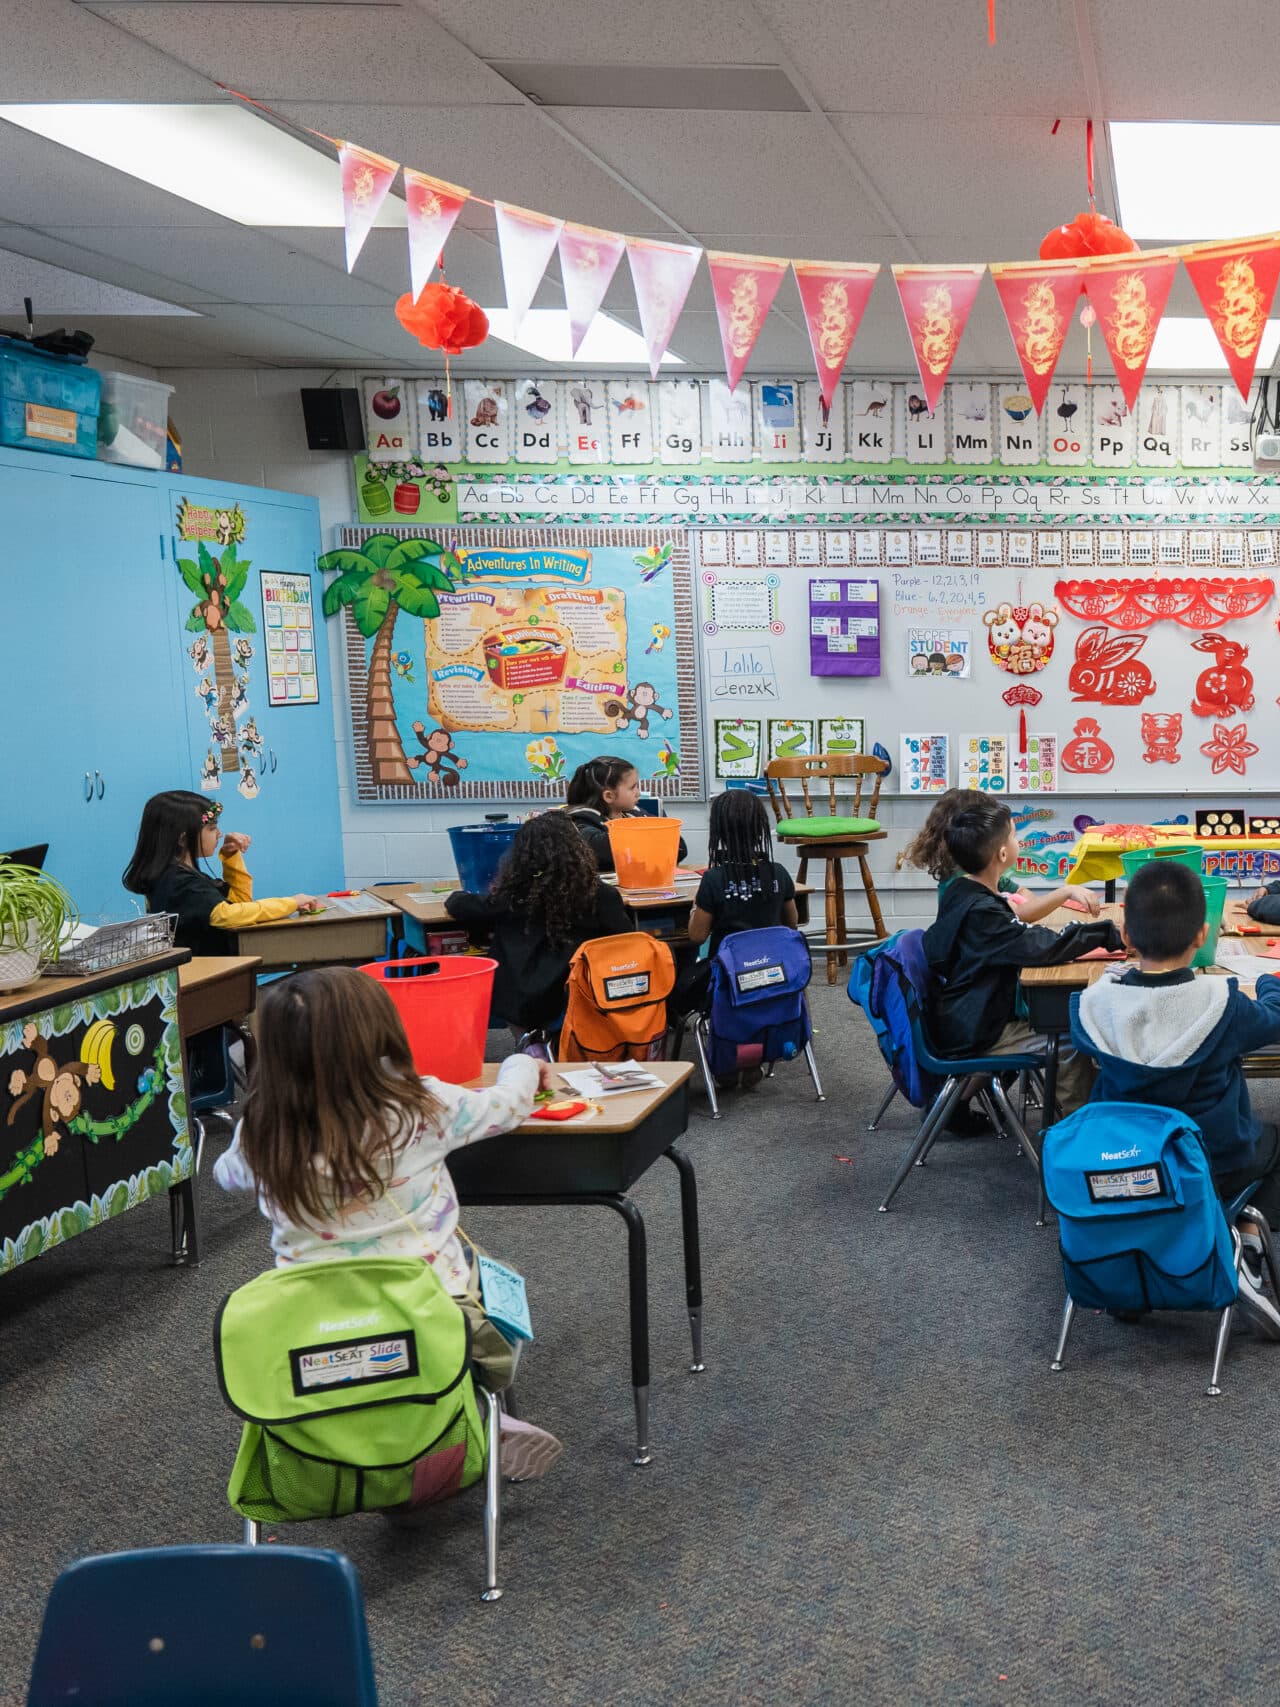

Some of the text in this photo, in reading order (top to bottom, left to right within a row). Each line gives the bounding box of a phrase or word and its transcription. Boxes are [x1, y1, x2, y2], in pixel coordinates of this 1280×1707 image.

[376, 433, 403, 449] Aa
[427, 433, 452, 447] Bb
[475, 433, 499, 448] Cc
[523, 433, 550, 448] Dd
[577, 436, 599, 450] Ee
[621, 434, 641, 449] Ff
[666, 434, 693, 453] Gg
[719, 432, 744, 447] Hh
[773, 434, 787, 449] Ii
[815, 432, 832, 451] Jj
[859, 433, 883, 448] Kk
[918, 434, 933, 449] Ll
[956, 435, 988, 449] Mm
[1007, 436, 1032, 449] Nn
[1053, 437, 1081, 453] Oo
[1100, 438, 1124, 455] Pp
[1143, 437, 1172, 455] Qq
[1191, 437, 1211, 451] Rr
[1230, 438, 1249, 451] Ss
[464, 486, 488, 503] Aa
[535, 487, 558, 503] Cc
[571, 487, 594, 504] Dd
[609, 488, 628, 504] Ee
[639, 488, 660, 504] Ff
[673, 488, 700, 512] Gg
[710, 488, 734, 504] Hh
[771, 488, 792, 512] Jj
[805, 488, 826, 503] Kk
[841, 488, 858, 503] Ll
[872, 488, 904, 503] Mm
[914, 488, 937, 503] Nn
[946, 487, 971, 503] Oo
[981, 488, 1003, 511] Pp
[1012, 487, 1041, 512] Qq
[1049, 488, 1070, 504] Rr
[1081, 488, 1100, 504] Ss
[1109, 488, 1128, 504] Tt
[1175, 488, 1194, 504] Vv
[1207, 488, 1239, 504] Ww
[1247, 488, 1269, 504] Xx
[467, 557, 583, 576] Adventures In Writing
[266, 589, 309, 603] BIRTHDAY
[548, 592, 596, 604] Drafting
[531, 616, 537, 625] 2
[911, 630, 952, 641] SECRET
[911, 640, 968, 653] STUDENT
[724, 651, 763, 673] Lalilo
[437, 666, 480, 680] Revising
[575, 680, 617, 693] Editing
[969, 739, 989, 753] 56
[910, 758, 930, 772] 27
[968, 758, 989, 773] 32
[910, 776, 930, 790] 37
[1019, 776, 1040, 789] 30
[1018, 832, 1075, 848] Self-Control
[1016, 857, 1049, 874] The
[1202, 852, 1255, 876] pirit
[1132, 1171, 1153, 1180] Slide
[370, 1343, 401, 1356] Slide
